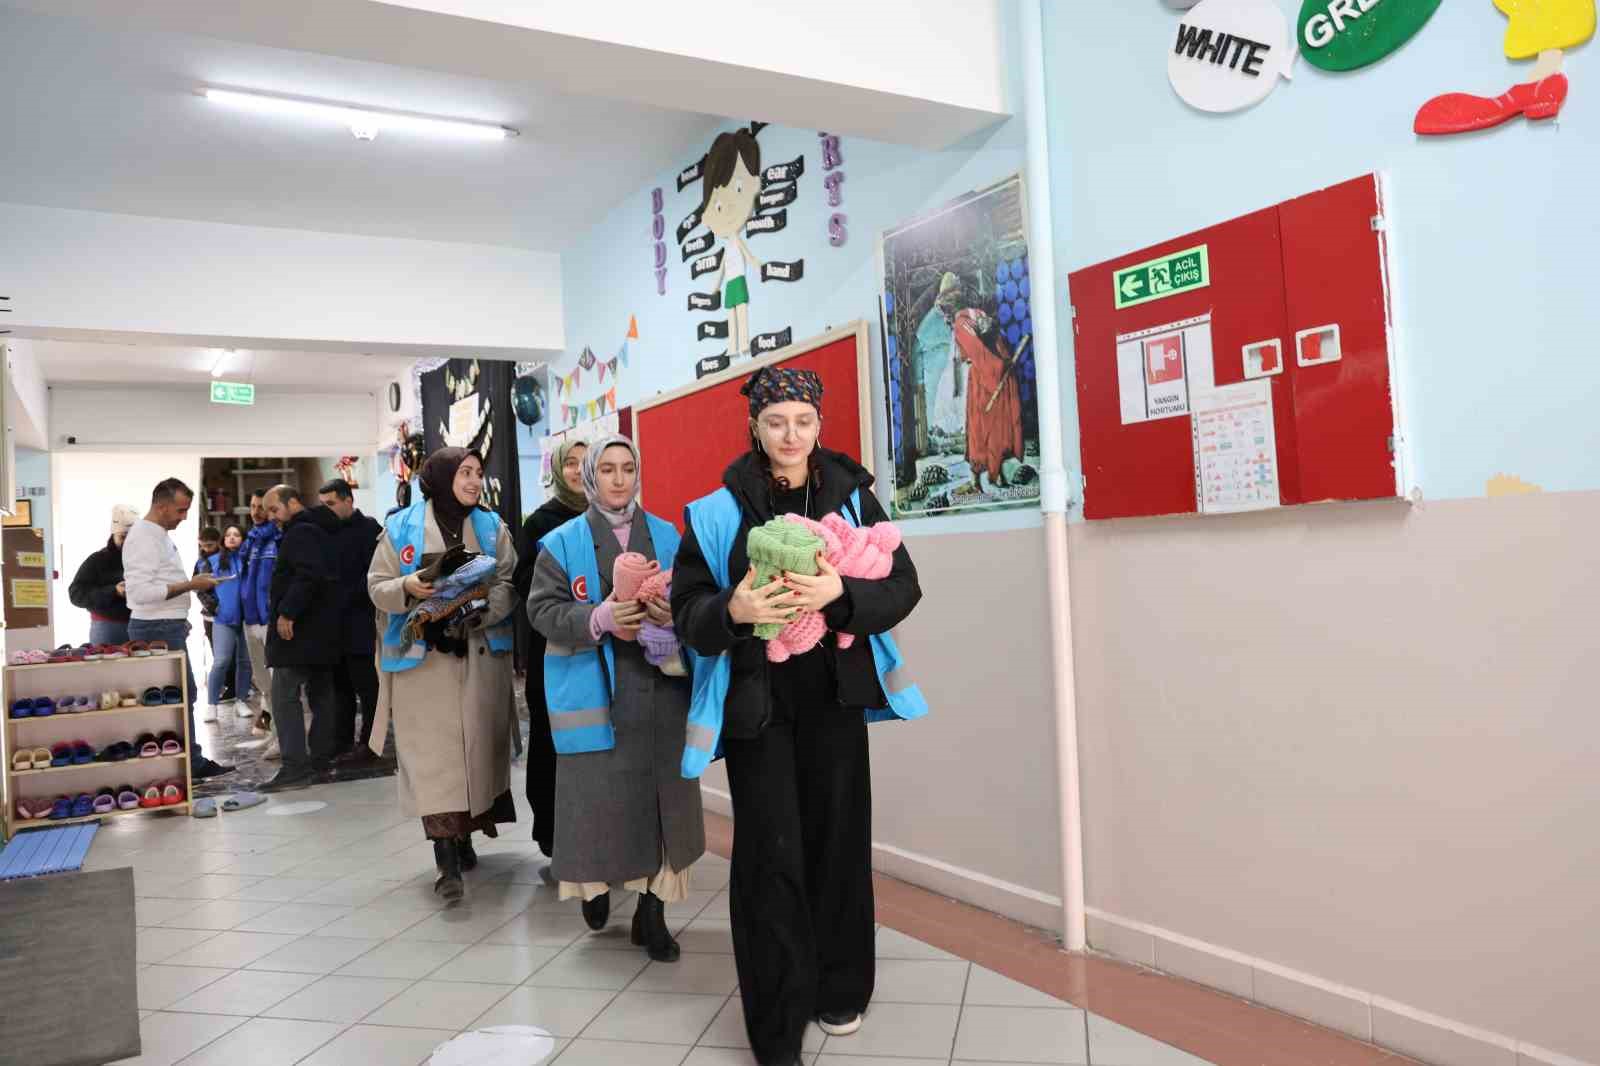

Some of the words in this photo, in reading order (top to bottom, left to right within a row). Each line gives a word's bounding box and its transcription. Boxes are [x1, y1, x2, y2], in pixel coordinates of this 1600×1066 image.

[1175, 23, 1271, 77] WHITE
[767, 166, 788, 180] ear
[747, 216, 775, 231] mouth
[651, 187, 667, 296] BODY
[695, 255, 717, 271] arm
[766, 263, 790, 278] hand
[1176, 257, 1198, 273] ACİL
[1174, 269, 1200, 286] ÇIKIŞ
[758, 335, 777, 349] foot
[701, 359, 720, 371] toes
[1153, 394, 1179, 405] YANGIN
